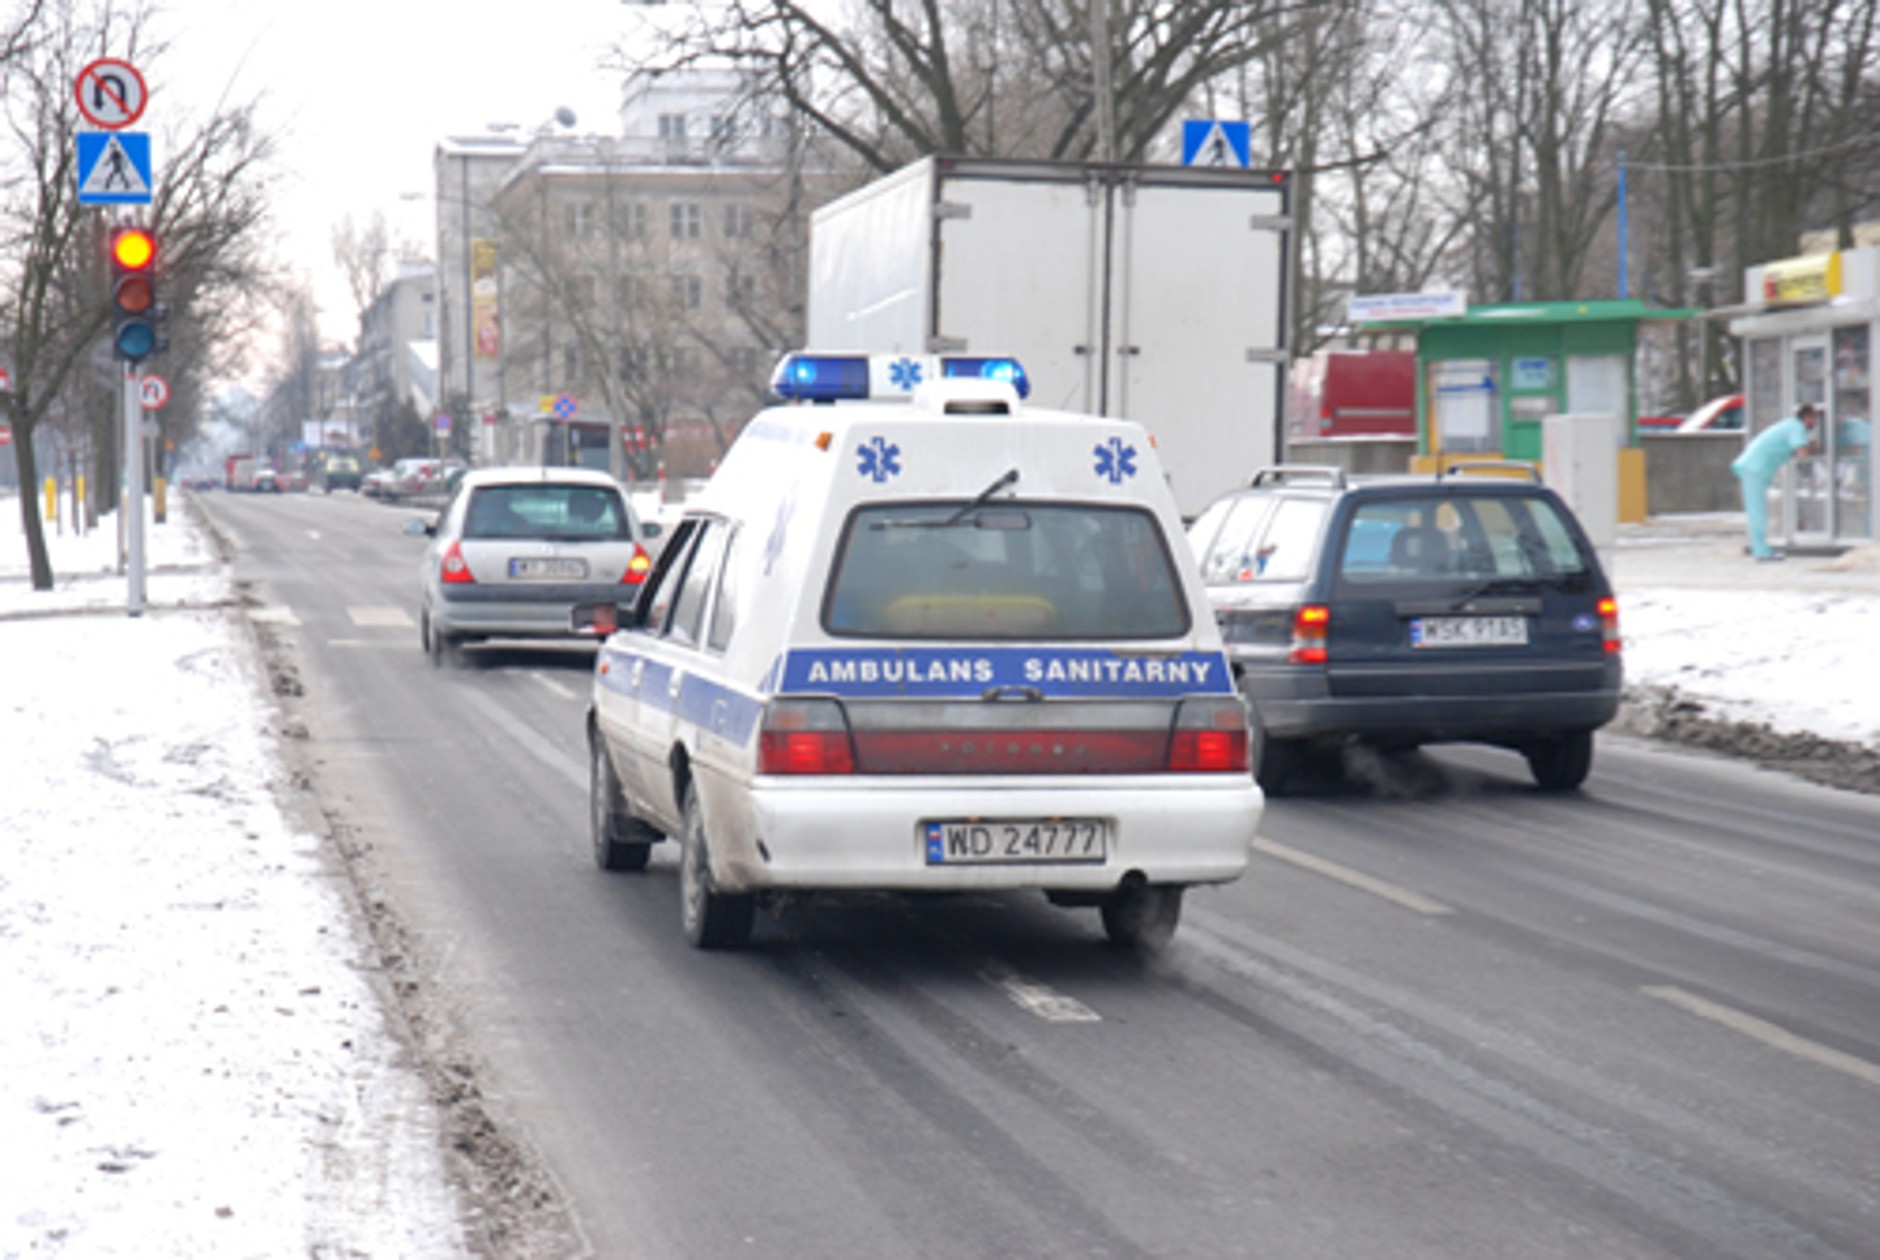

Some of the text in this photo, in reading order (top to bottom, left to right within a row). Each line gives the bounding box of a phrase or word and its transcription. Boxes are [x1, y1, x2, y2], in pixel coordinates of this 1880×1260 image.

[808, 658, 1212, 684] AMBULANS SANITARNY
[948, 826, 1096, 856] WD 24777
